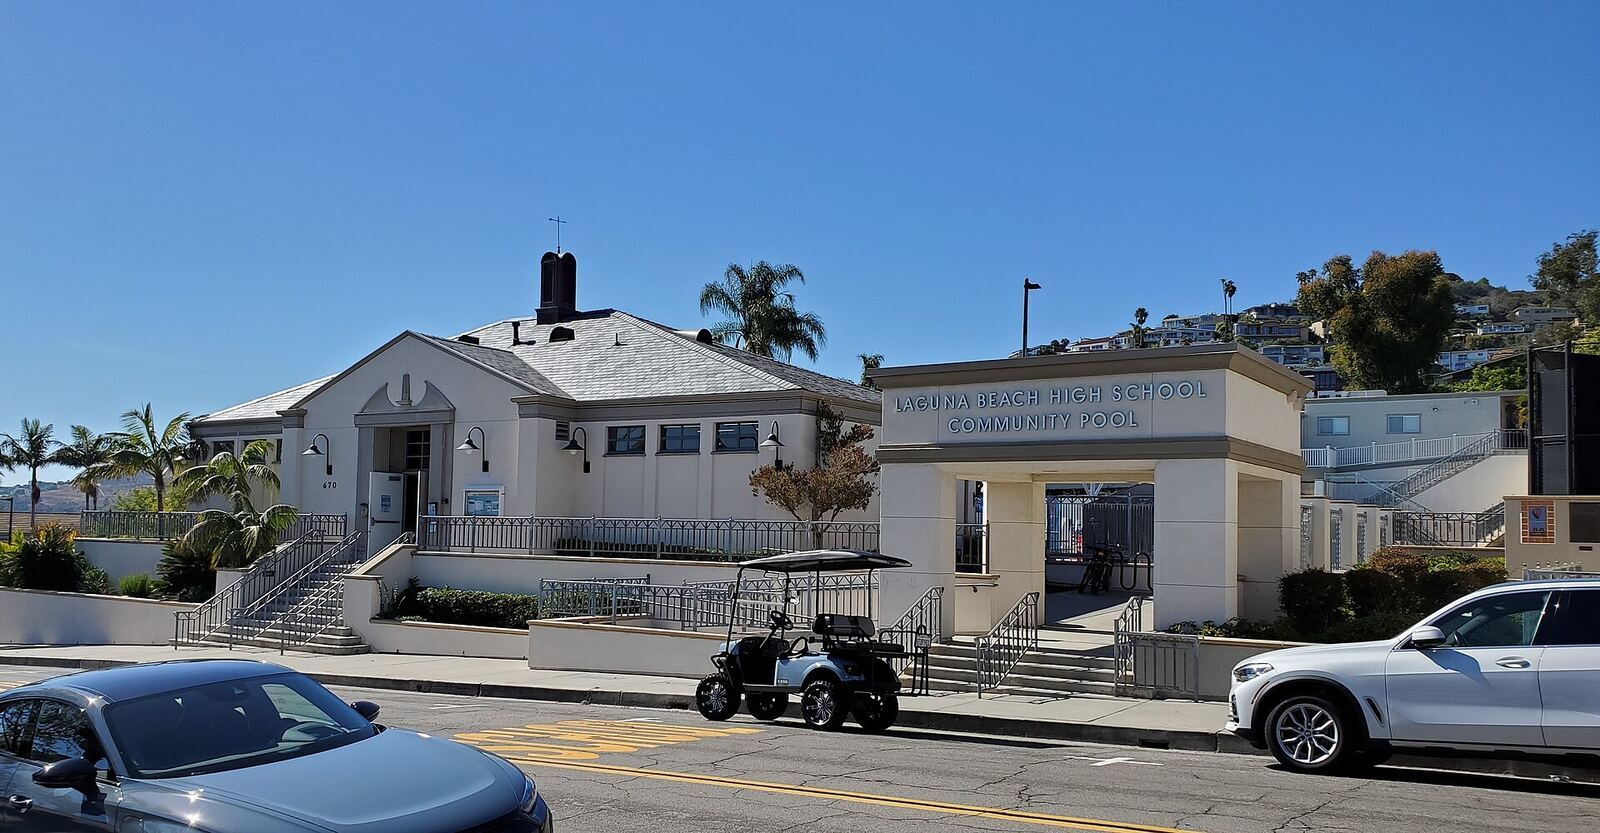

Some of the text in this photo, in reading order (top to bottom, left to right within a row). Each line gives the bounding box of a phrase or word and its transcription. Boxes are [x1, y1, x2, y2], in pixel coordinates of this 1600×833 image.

[894, 380, 1207, 413] LAGUNA BEACH HIGH SCHOOL
[948, 410, 1138, 434] COMMUNITY POOL
[322, 481, 337, 489] 670
